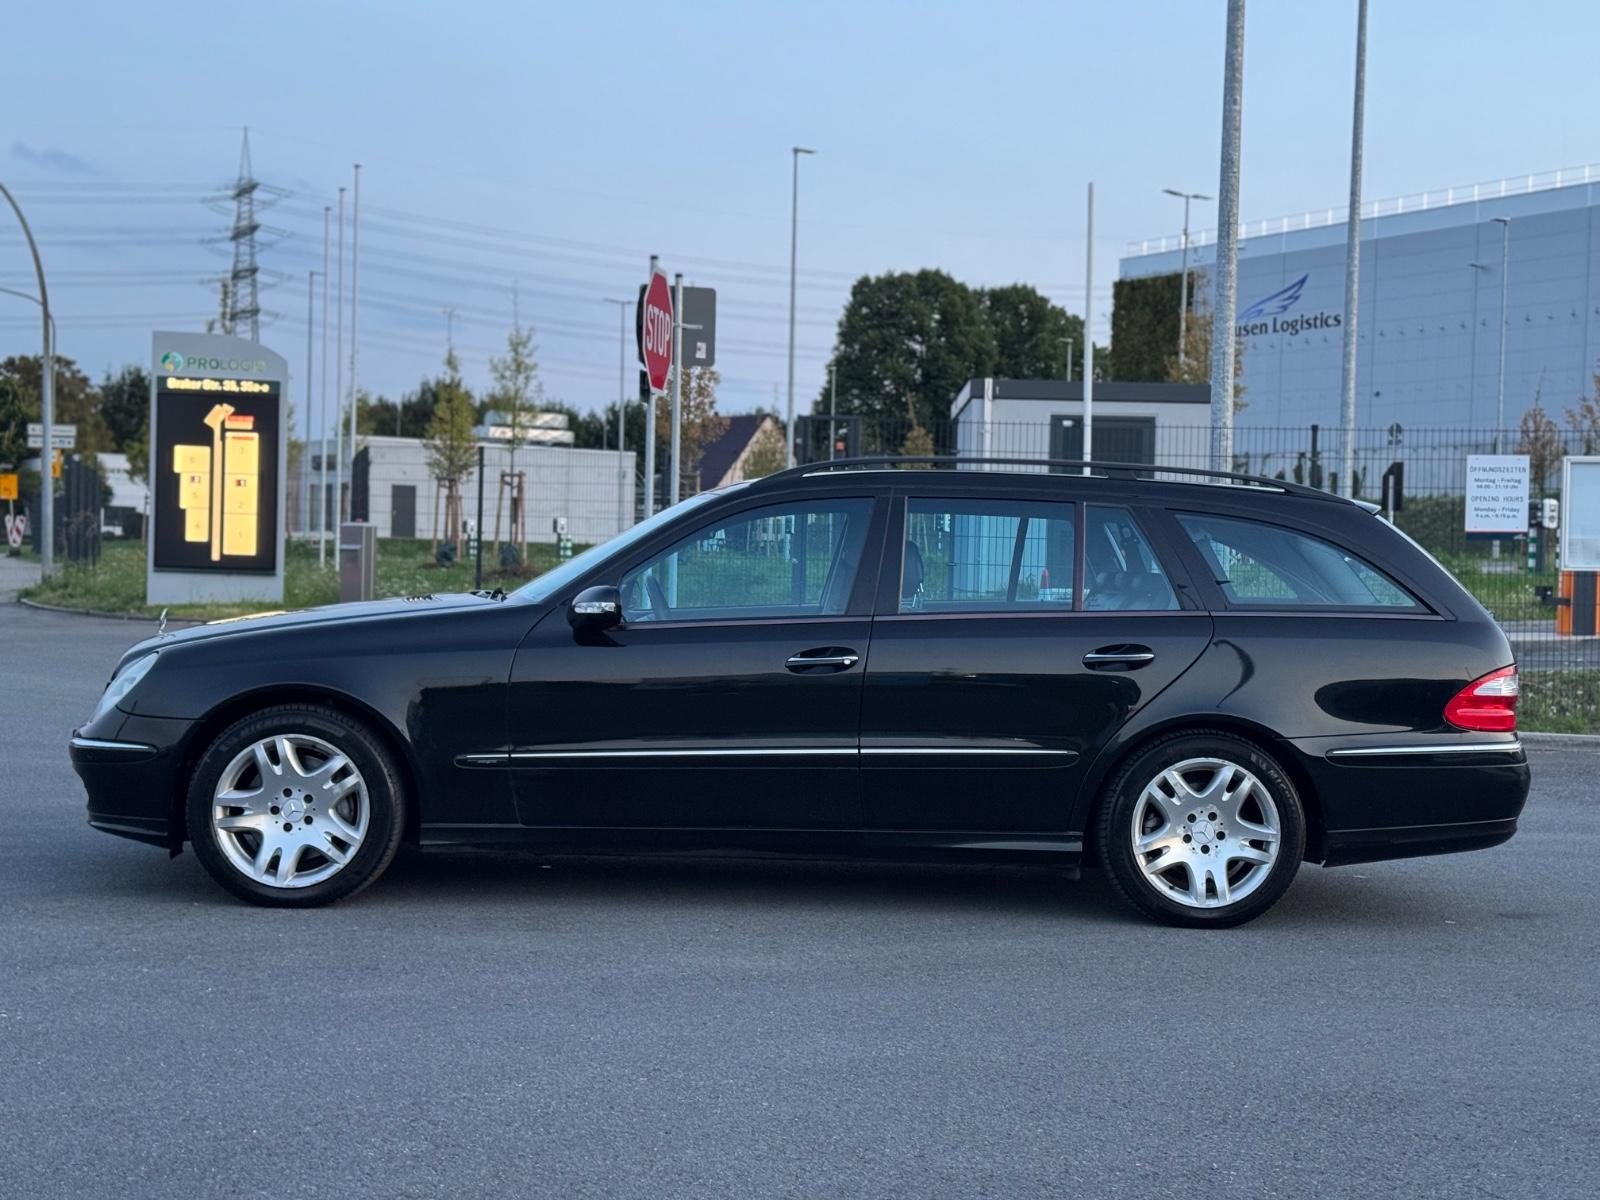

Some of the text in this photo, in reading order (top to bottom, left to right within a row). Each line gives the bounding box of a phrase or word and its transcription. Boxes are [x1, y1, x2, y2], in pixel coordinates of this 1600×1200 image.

[646, 303, 671, 358] STOP
[1235, 312, 1342, 338] usen Logistics
